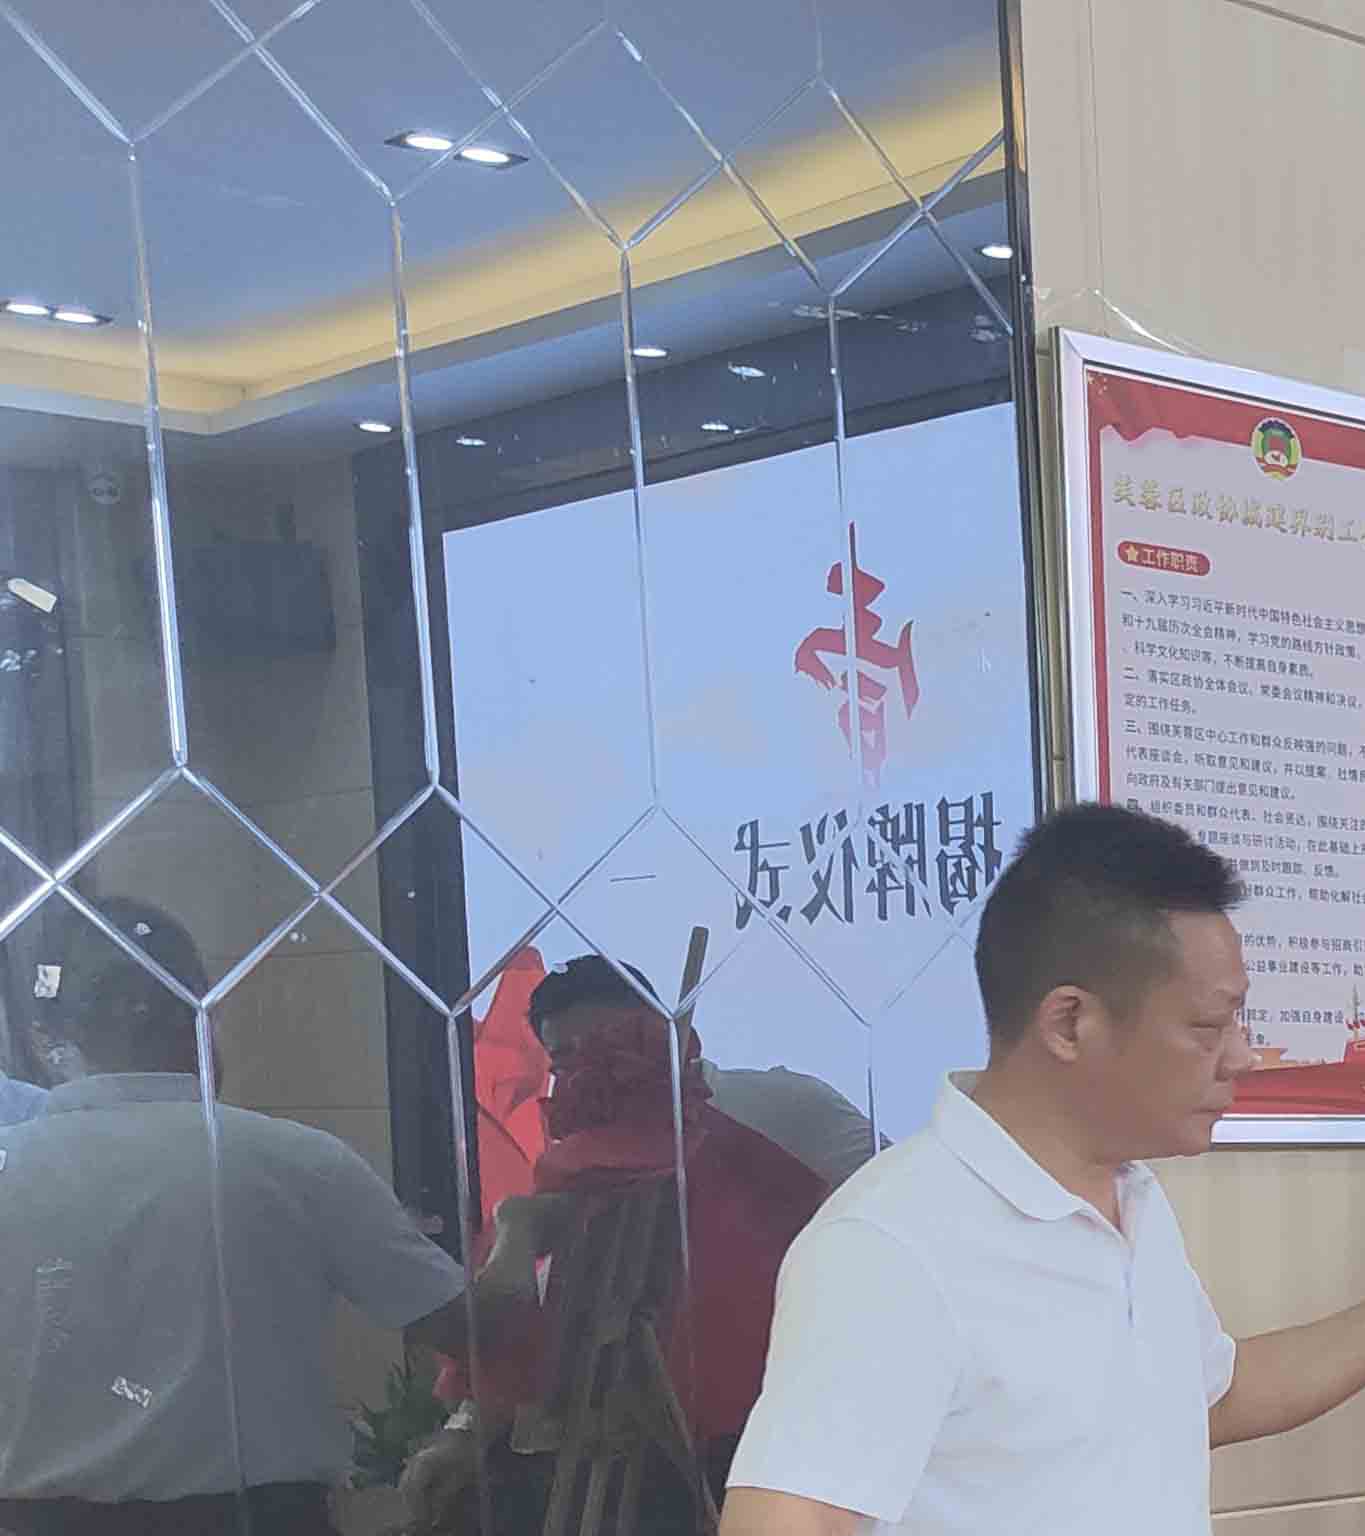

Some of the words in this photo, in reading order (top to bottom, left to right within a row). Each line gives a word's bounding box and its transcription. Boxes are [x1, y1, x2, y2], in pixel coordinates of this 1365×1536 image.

[1140, 546, 1201, 574] 工作职责
[1123, 692, 1198, 716] 定的工作任务。
